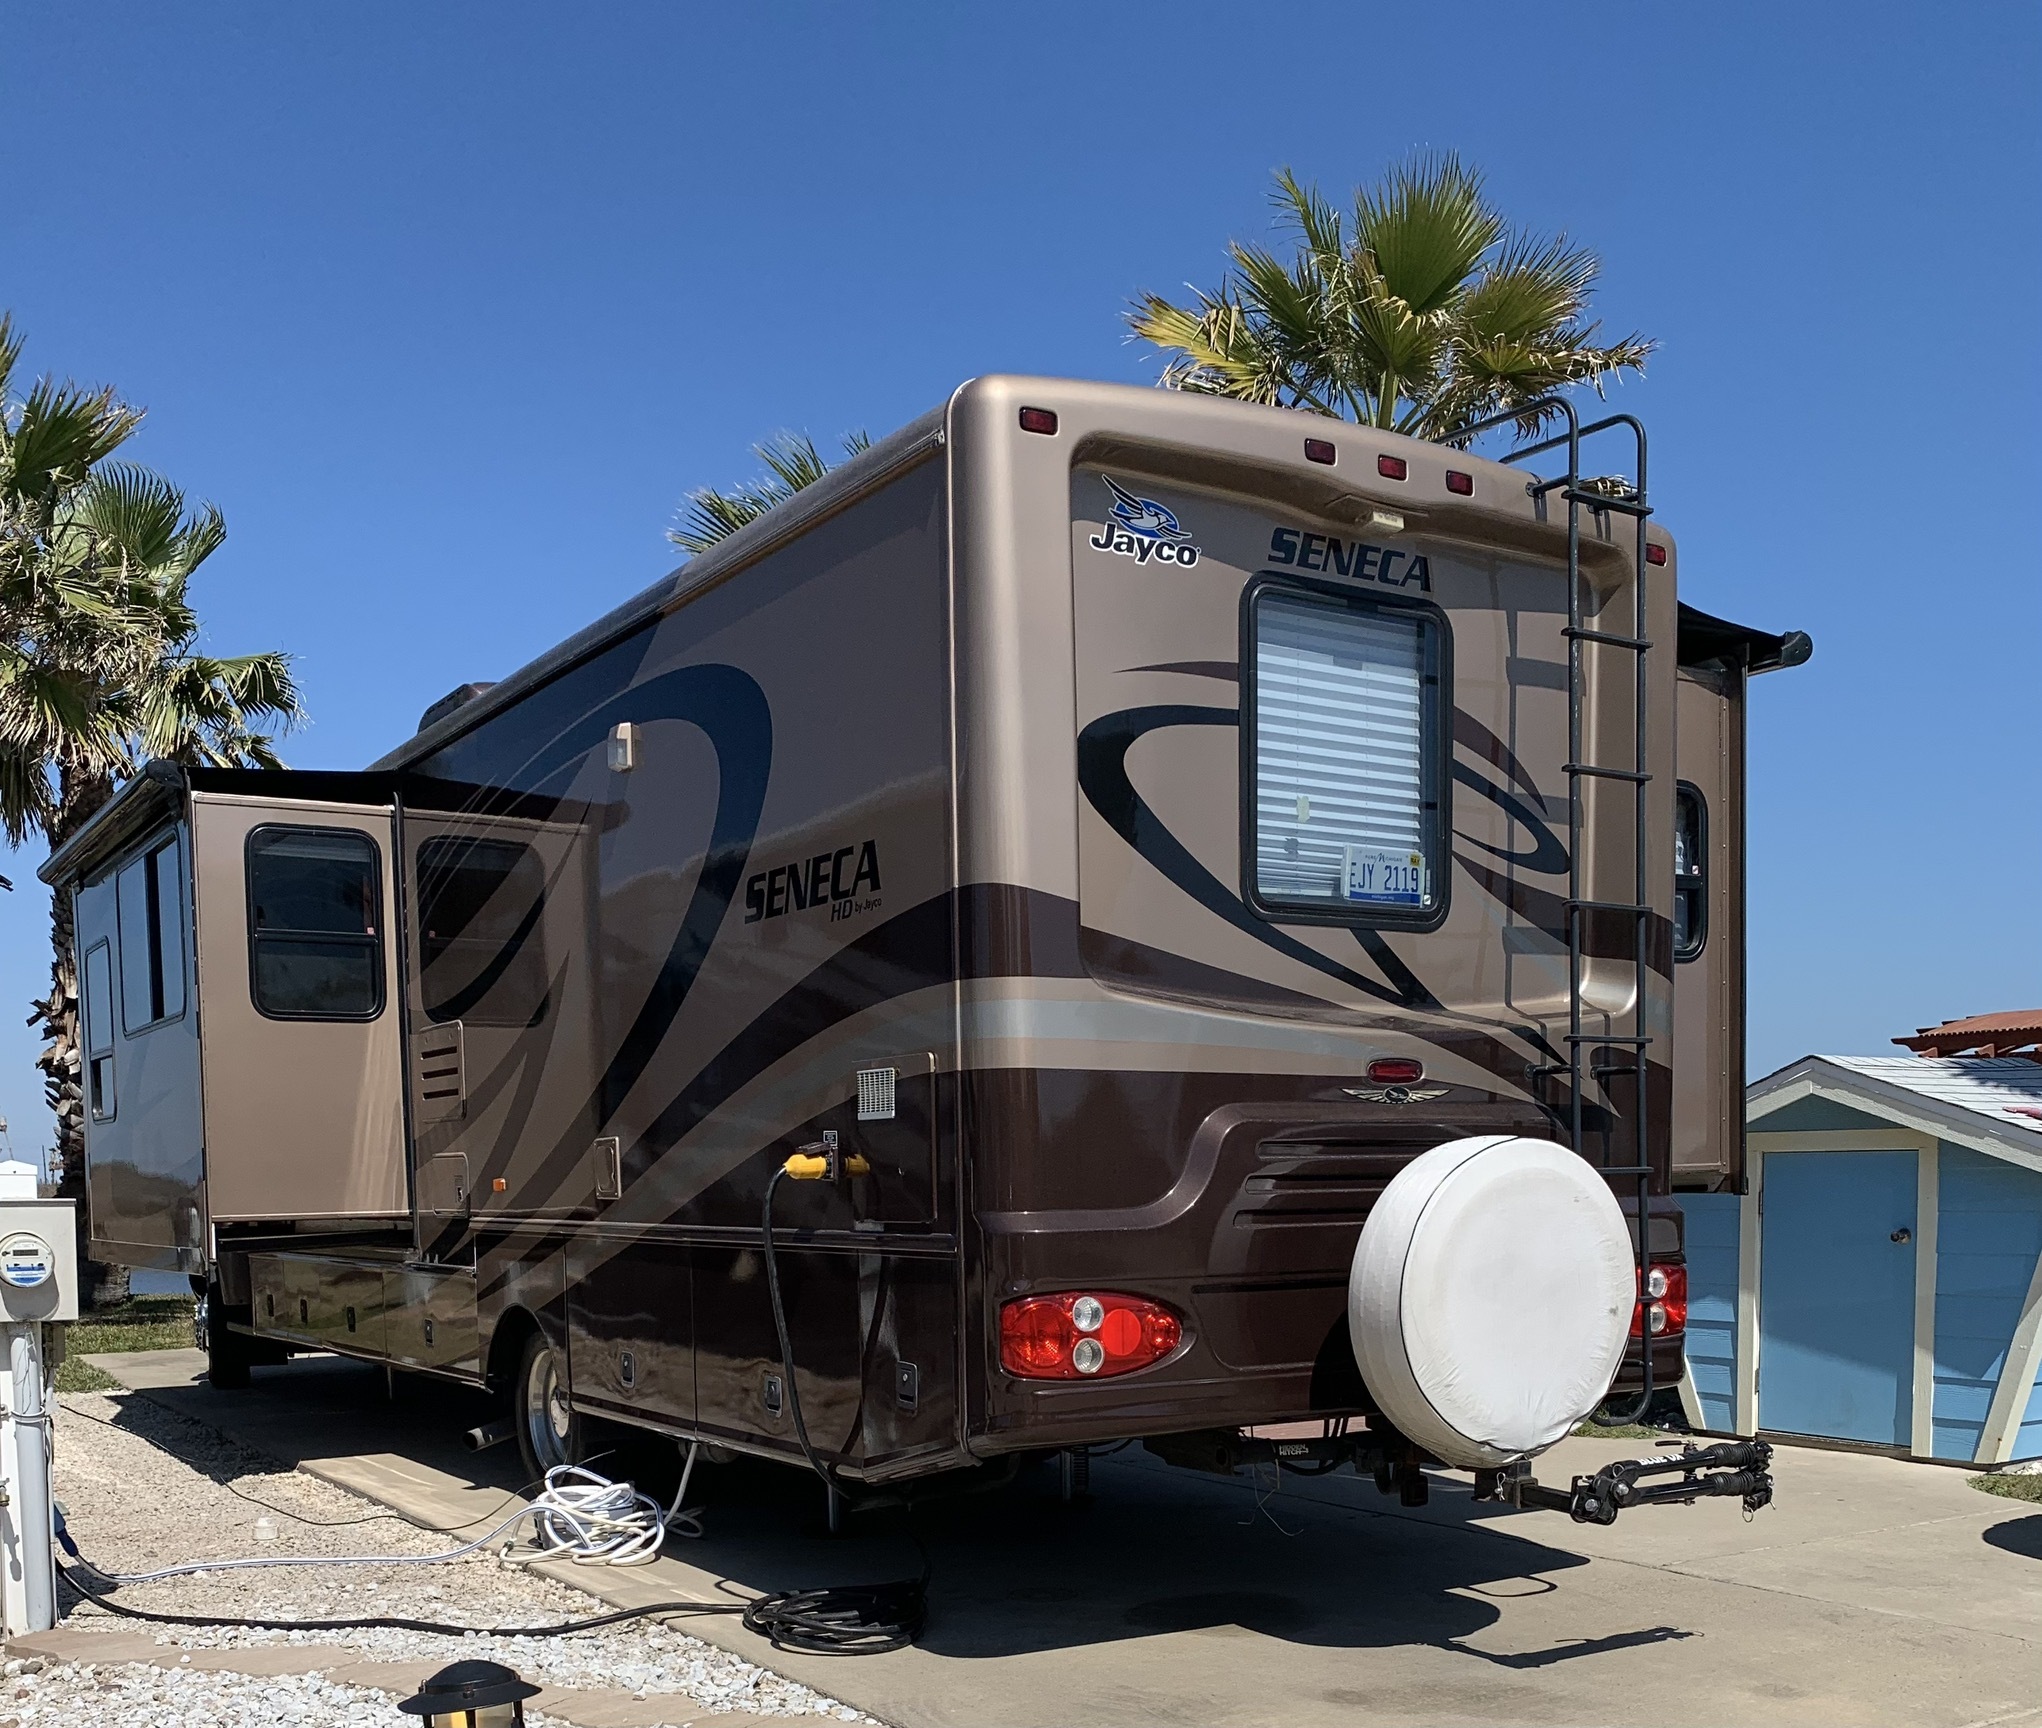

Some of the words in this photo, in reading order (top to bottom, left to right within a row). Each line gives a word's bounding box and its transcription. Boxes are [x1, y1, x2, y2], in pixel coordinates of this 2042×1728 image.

[1090, 521, 1198, 568] Jayco
[1268, 527, 1431, 592] SENECA
[744, 839, 881, 924] SENECA
[1350, 862, 1374, 889] EJY
[1384, 865, 1419, 892] 2119
[831, 899, 853, 922] HD
[855, 901, 863, 913] by
[864, 898, 882, 911] Jayco
[1637, 1456, 1668, 1466] BLUE
